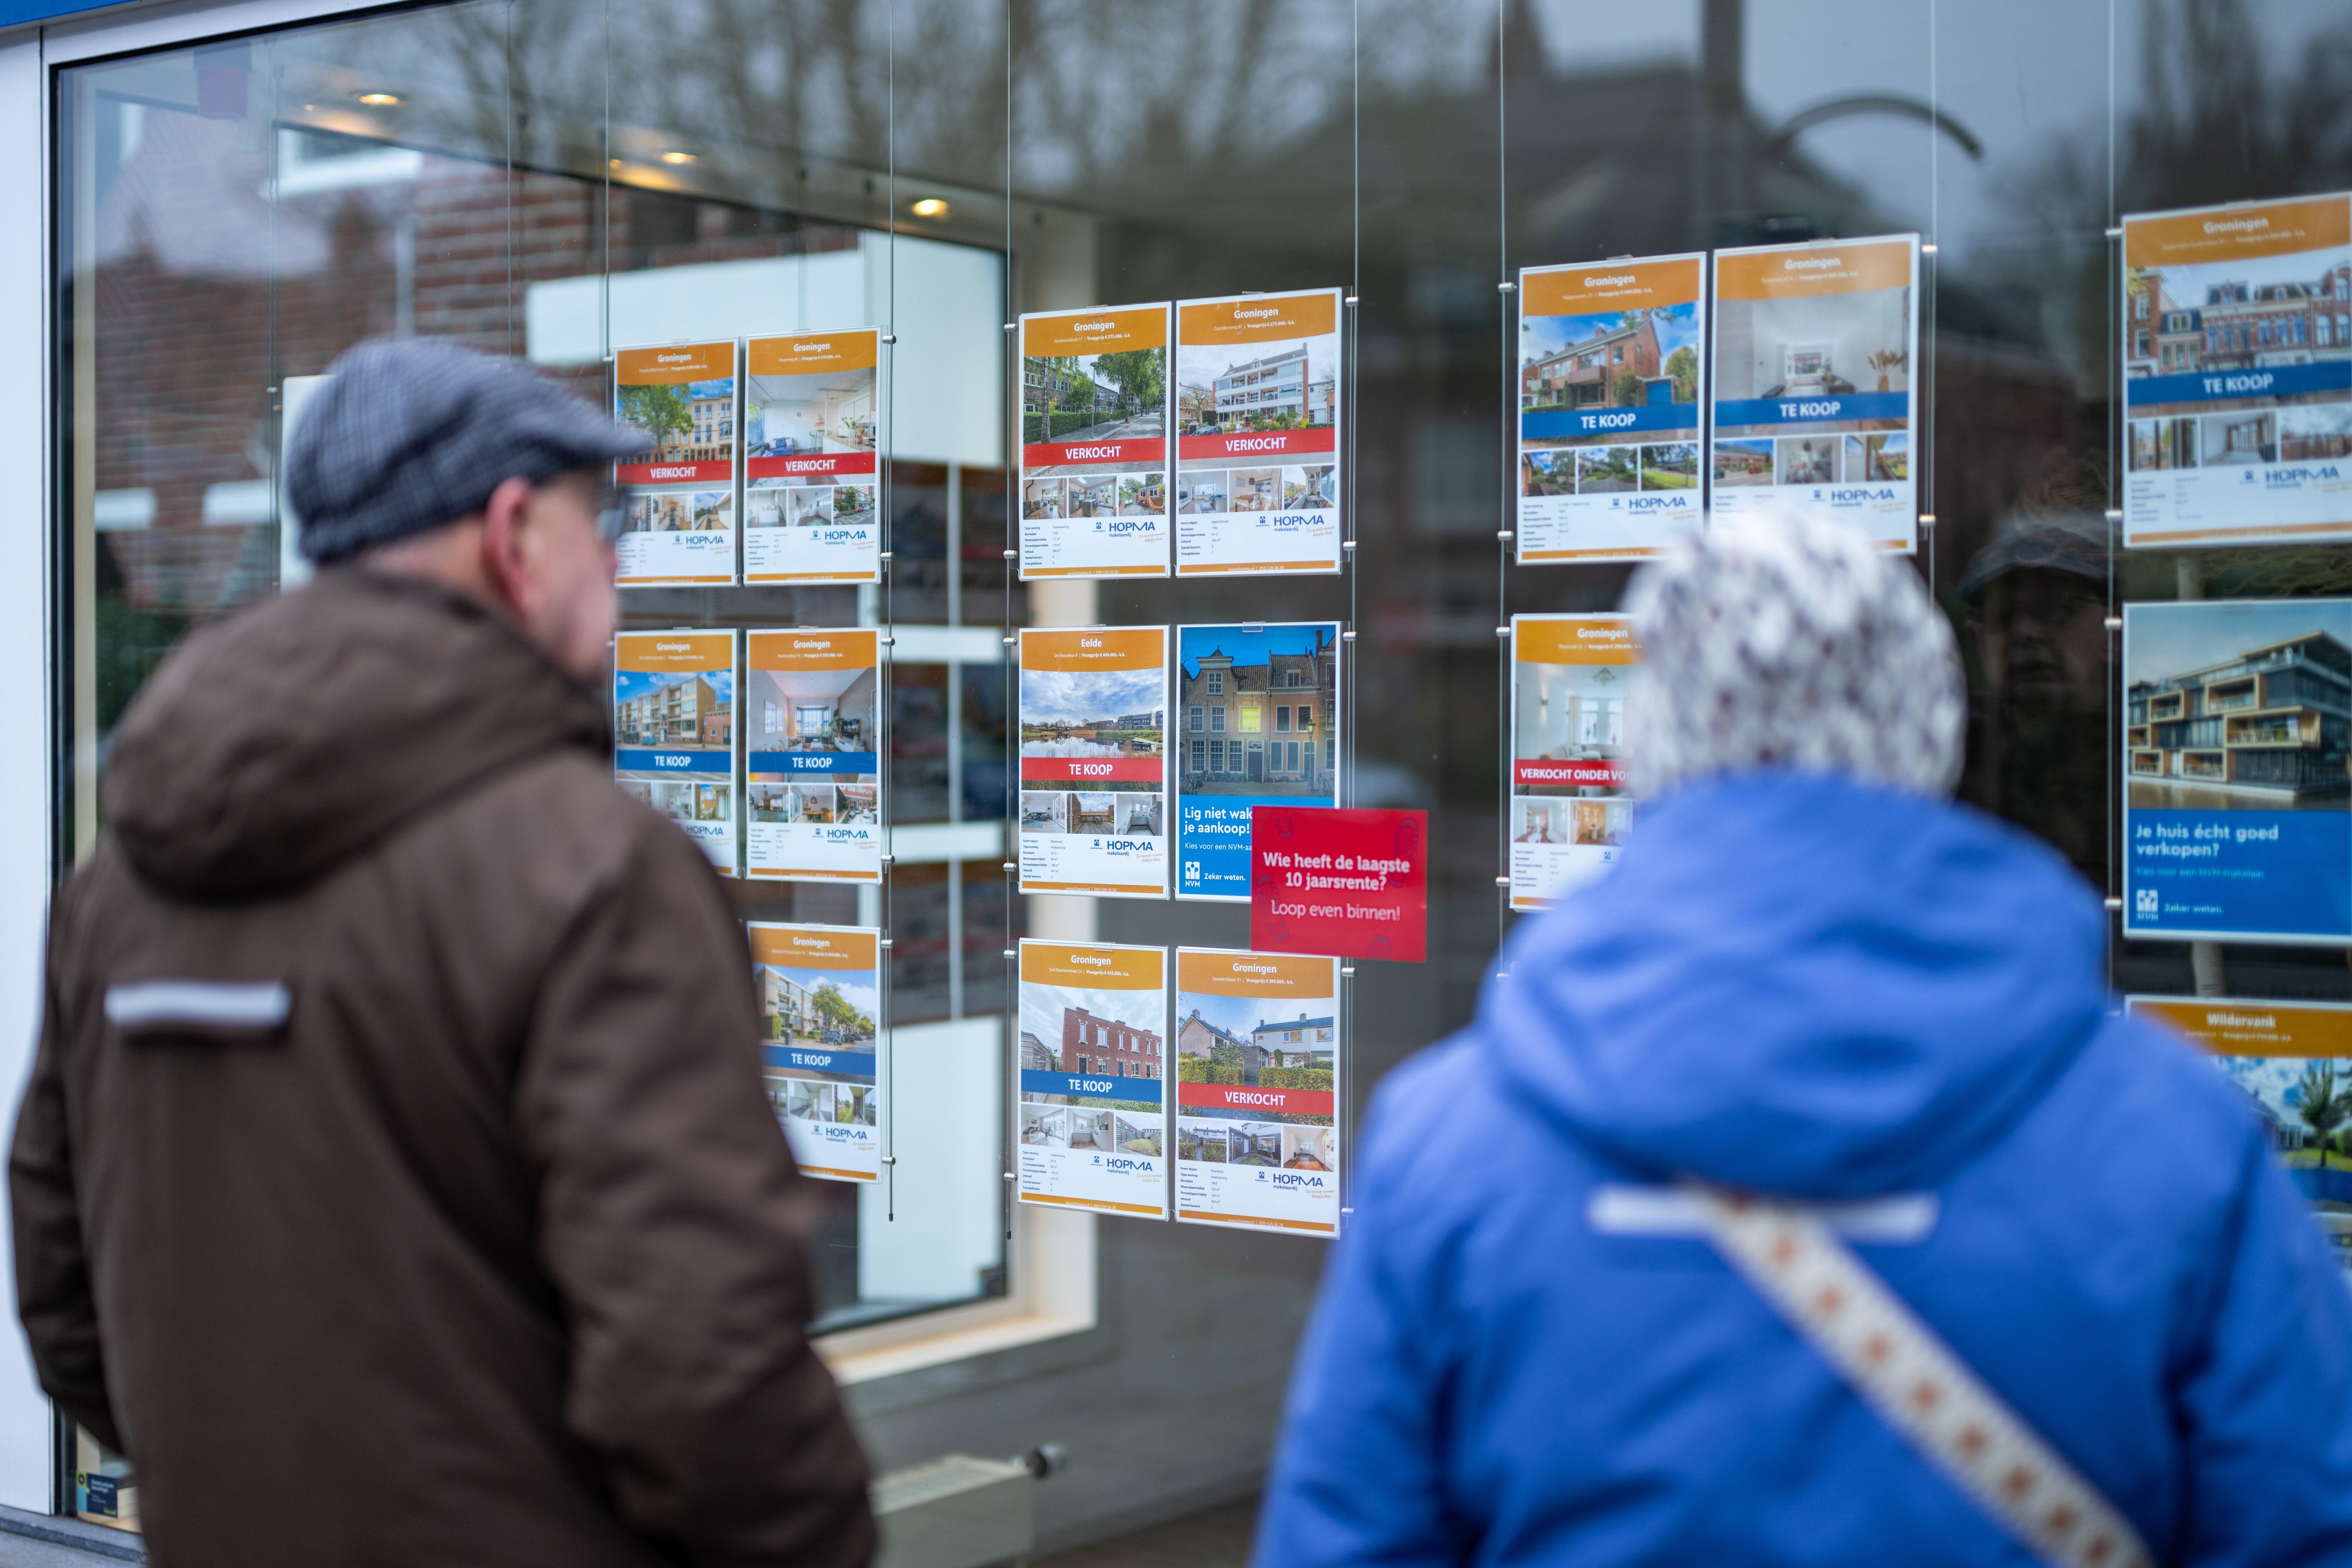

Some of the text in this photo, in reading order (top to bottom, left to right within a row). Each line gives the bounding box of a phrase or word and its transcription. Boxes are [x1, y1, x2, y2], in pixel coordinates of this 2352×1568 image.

[2204, 218, 2269, 234] Groningen
[1785, 256, 1840, 272] Groningen
[1585, 275, 1635, 286] Groningen
[1234, 309, 1278, 318] Groningen
[1074, 321, 1114, 331] Groningen
[794, 343, 830, 352] Groningen
[657, 353, 691, 363] Groningen
[2204, 374, 2273, 395] TE KOOP
[1780, 401, 1840, 417] TE KOOP
[1581, 414, 1636, 429] TE KOOP
[1226, 437, 1286, 451] VERKOCHT
[1066, 446, 1121, 460] VERKOCHT
[786, 459, 835, 472] VERKOCHT
[650, 466, 696, 478] VERKOCHT
[2266, 466, 2339, 481] HOPMA
[1832, 489, 1894, 501] HOPMA
[1629, 497, 1686, 509] HOPMA
[1274, 515, 1324, 526] HOPMA
[1109, 522, 1155, 532] HOPMA
[686, 536, 723, 544] HOPMA
[825, 531, 866, 540] HOPMA
[1577, 628, 1628, 640] Groningen
[794, 640, 830, 650] Groningen
[1081, 639, 1102, 647] Eelde
[655, 756, 691, 767] TE KOOP
[792, 757, 832, 768] TE KOOP
[1069, 764, 1113, 775] TE KOOP
[1521, 768, 1573, 779] VERKOCHT
[1574, 769, 1609, 780] ONDER
[1185, 806, 1253, 821] Lig niet wak
[686, 826, 723, 835] HOPMA
[827, 830, 868, 838] HOPMA
[1184, 821, 1250, 836] je aankoop!
[2136, 823, 2279, 843] Je huis écht goed
[1107, 841, 1153, 851] HOPMA
[2136, 842, 2220, 859] verkopen?
[1263, 852, 1410, 875] Wie heeft de laagste
[1286, 872, 1387, 891] 10 jaarsrente?
[1271, 900, 1400, 921] Loop even binnen!
[2165, 903, 2189, 913] Zeker
[793, 937, 830, 948] Groningen
[1071, 955, 1111, 967] Groningen
[1233, 963, 1277, 975] Groningen
[2207, 1013, 2276, 1028] Wildervank
[791, 1053, 831, 1067] TE KOOP
[1069, 1079, 1112, 1093] TE KOOP
[1225, 1091, 1286, 1107] VERKOCHT
[826, 1128, 867, 1140] HOPMA
[1107, 1159, 1152, 1171] HOPMA
[1273, 1174, 1323, 1187] HOPMA
